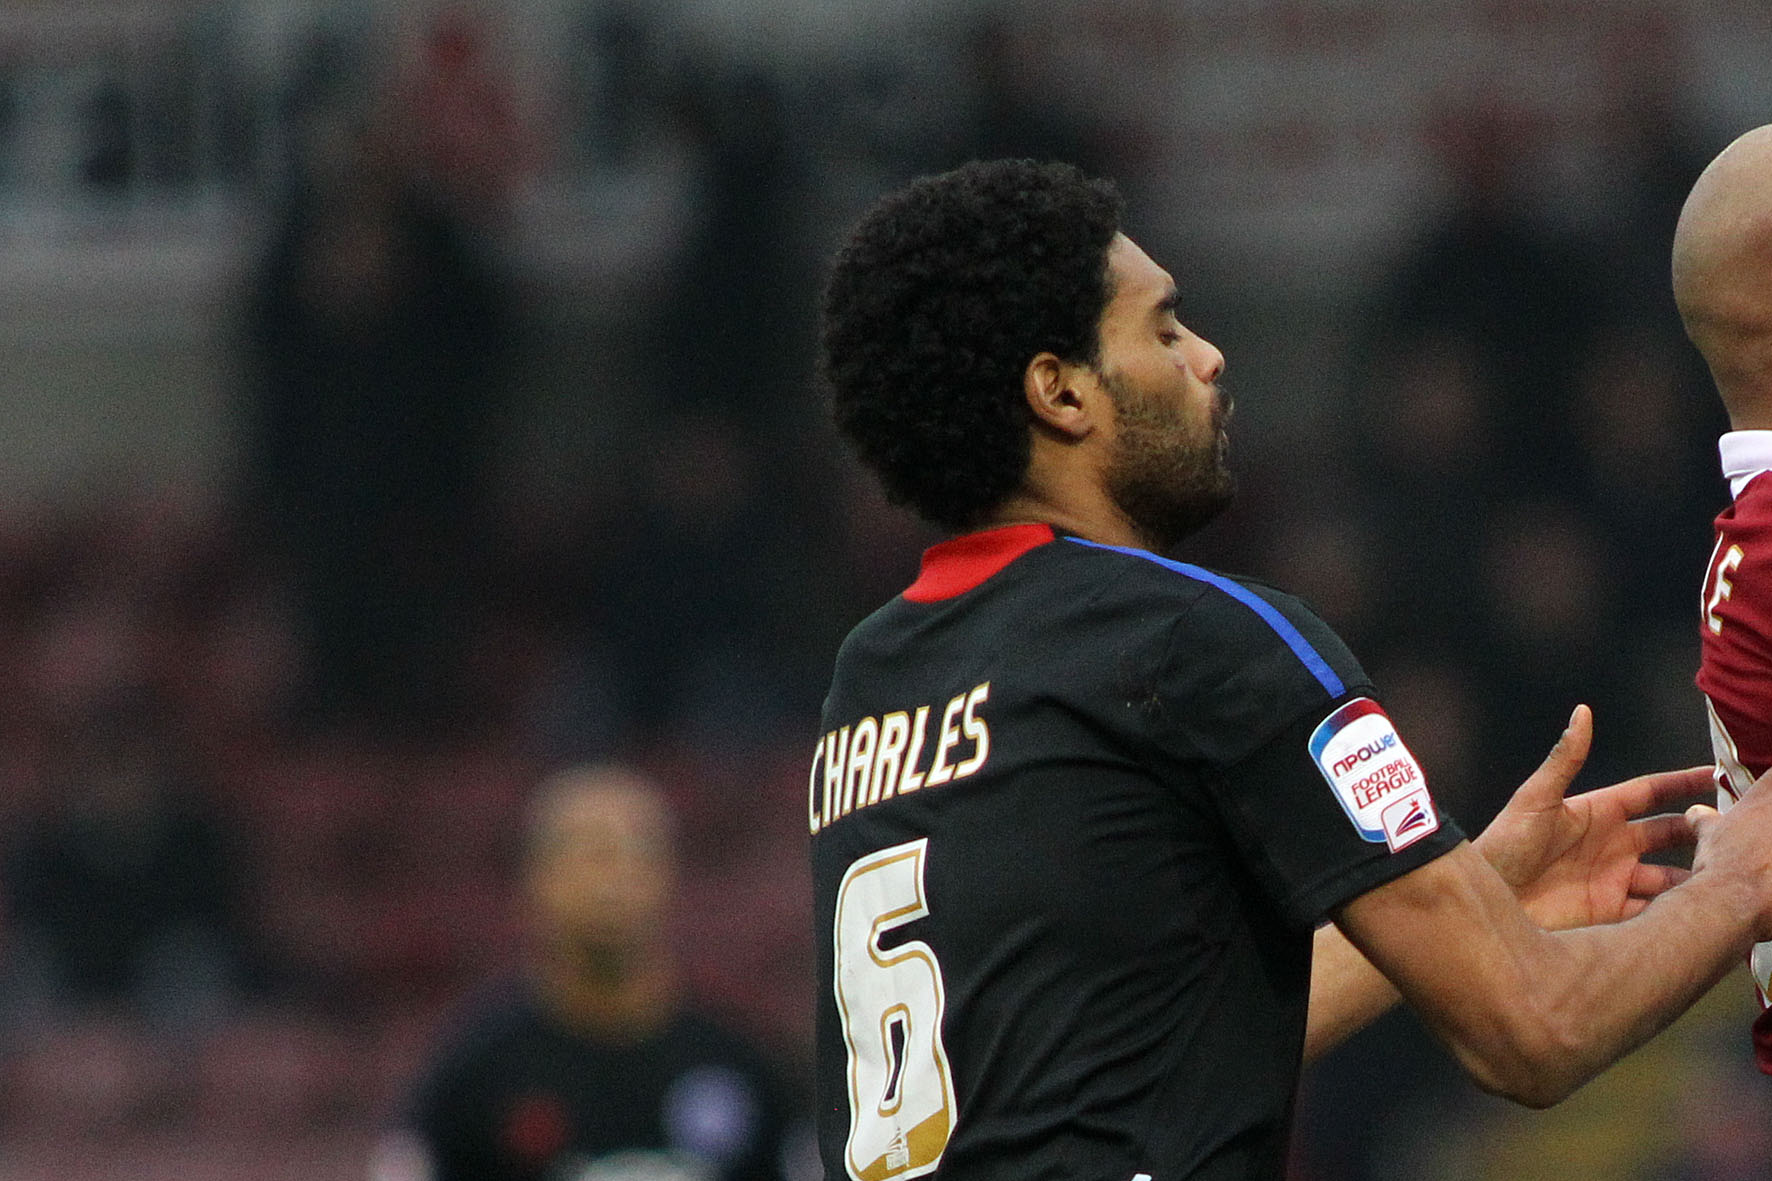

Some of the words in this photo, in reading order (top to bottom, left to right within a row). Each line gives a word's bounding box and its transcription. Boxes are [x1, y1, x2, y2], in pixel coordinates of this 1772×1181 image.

[808, 680, 991, 836] CHARLES
[1332, 732, 1397, 779] npower
[1351, 757, 1411, 795] FOOTBALL
[1355, 766, 1418, 810] LEAGUE
